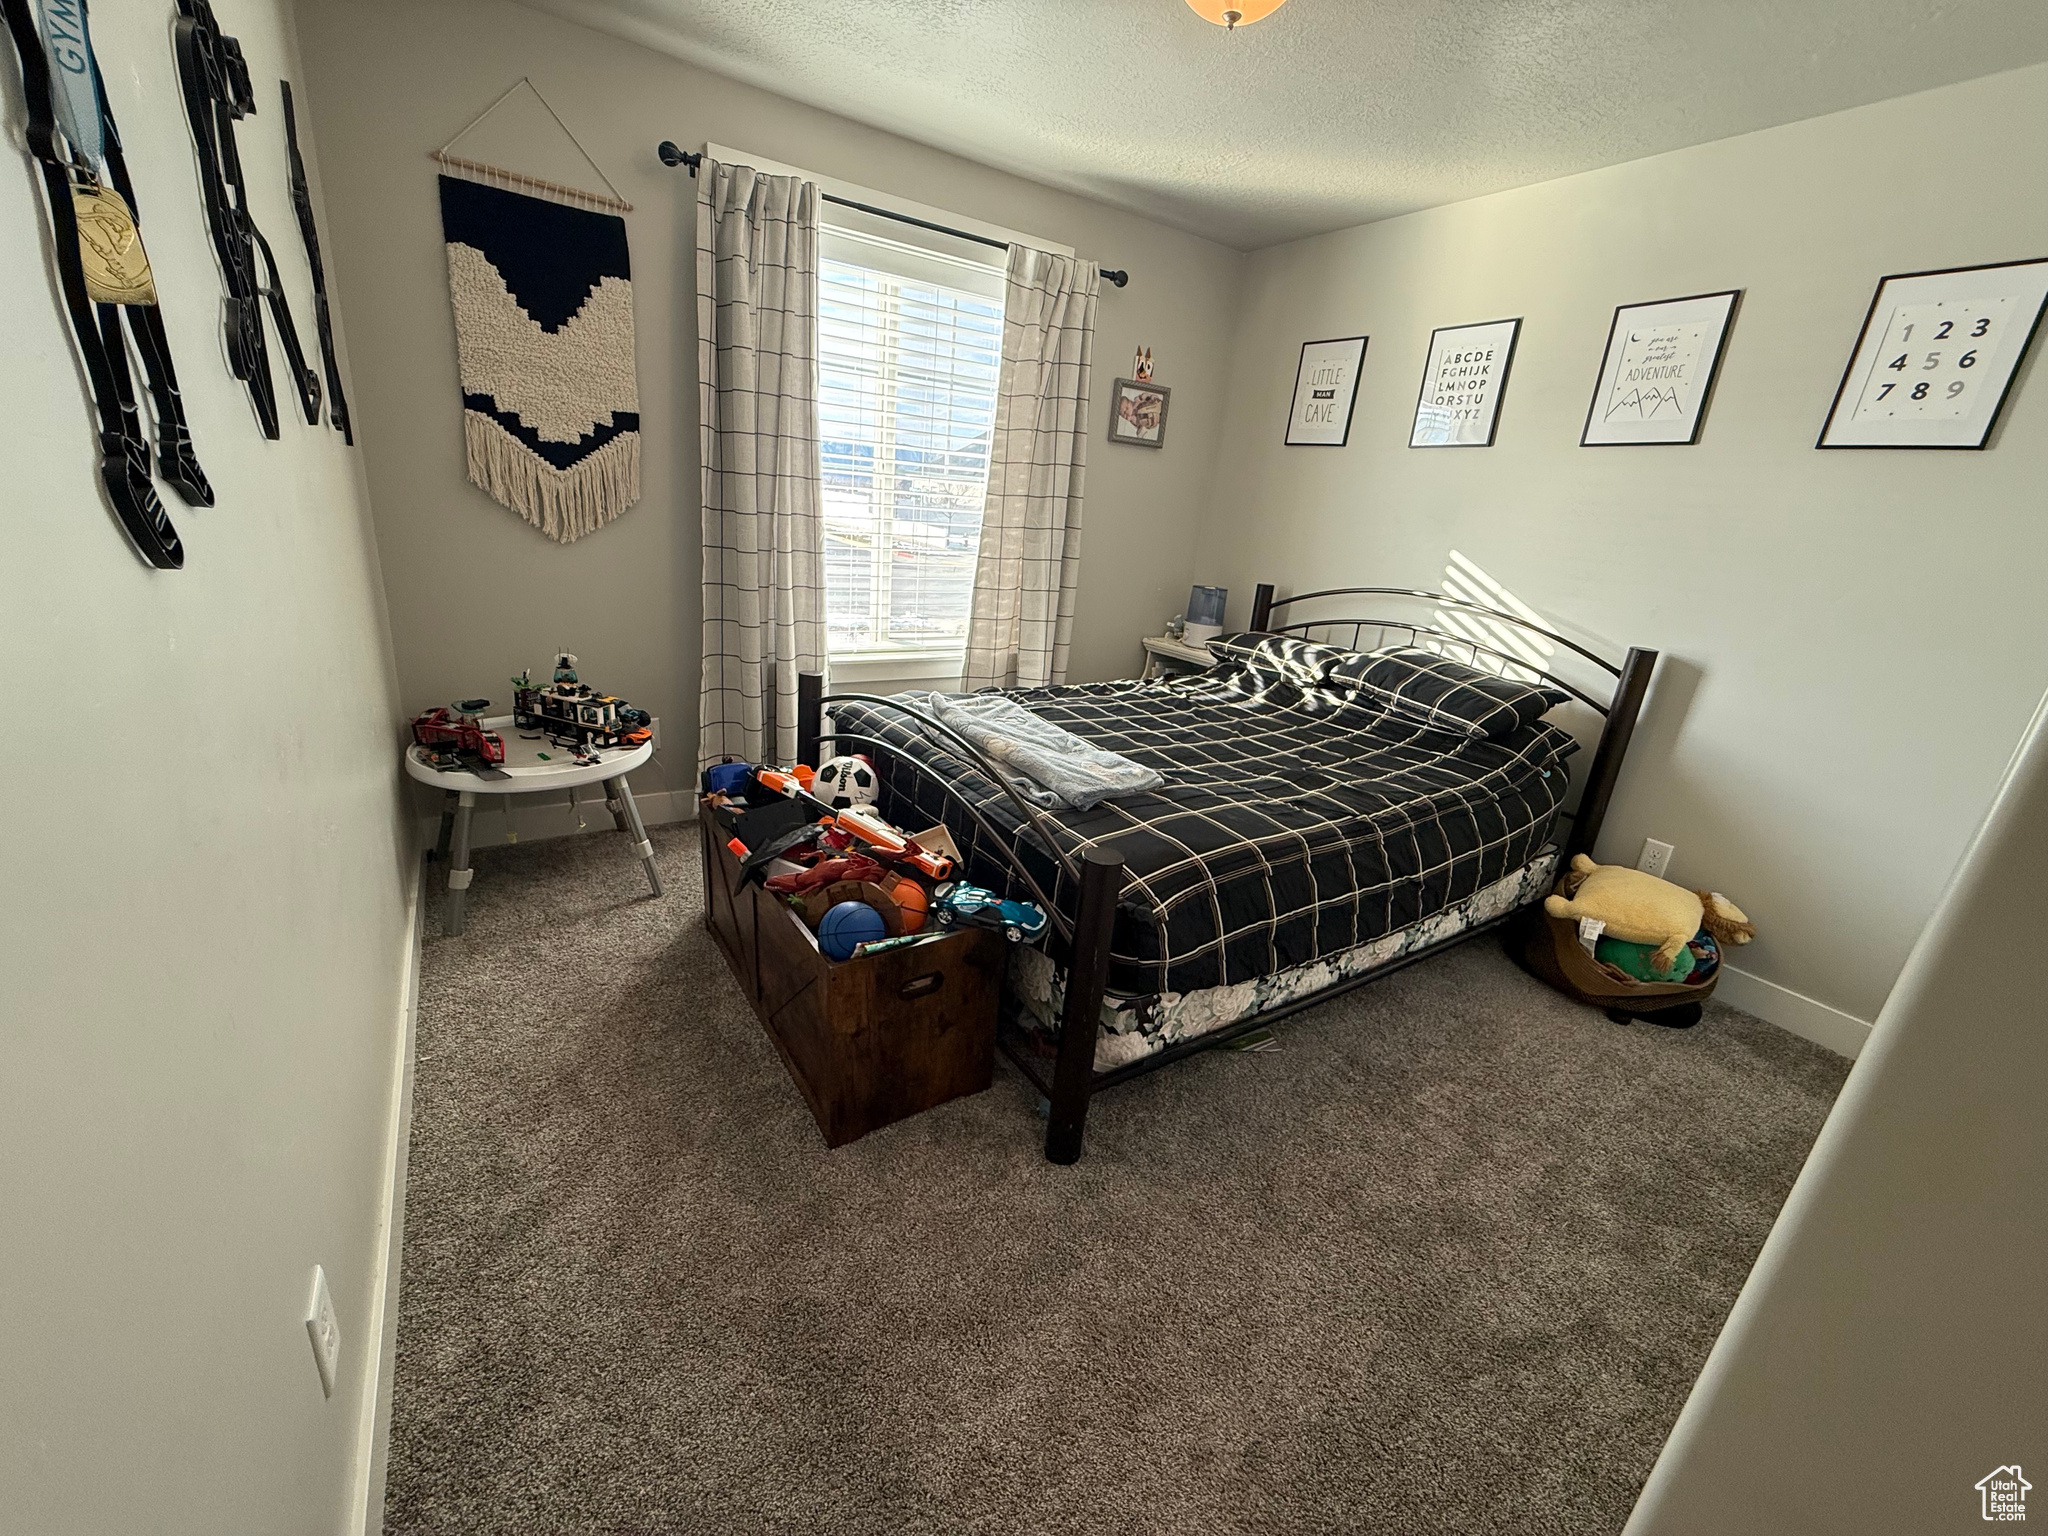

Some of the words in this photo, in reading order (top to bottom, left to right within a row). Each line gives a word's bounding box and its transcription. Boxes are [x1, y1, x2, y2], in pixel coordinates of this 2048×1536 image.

[1902, 324, 1914, 342] 1
[1934, 321, 1954, 340] 2
[1970, 318, 1990, 337] 3
[1647, 337, 1664, 347] you
[1642, 352, 1675, 364] greatest
[1888, 353, 1908, 371] 4
[1922, 352, 1940, 370] 5
[1958, 349, 1977, 368] 6
[1311, 368, 1343, 386] LITTLE
[1625, 364, 1686, 381] ADVENTURE
[1876, 383, 1896, 401] 7
[1911, 382, 1930, 400] 8
[1946, 381, 1965, 399] 9
[1305, 404, 1336, 423] CAVE
[838, 761, 853, 793] Wilson
